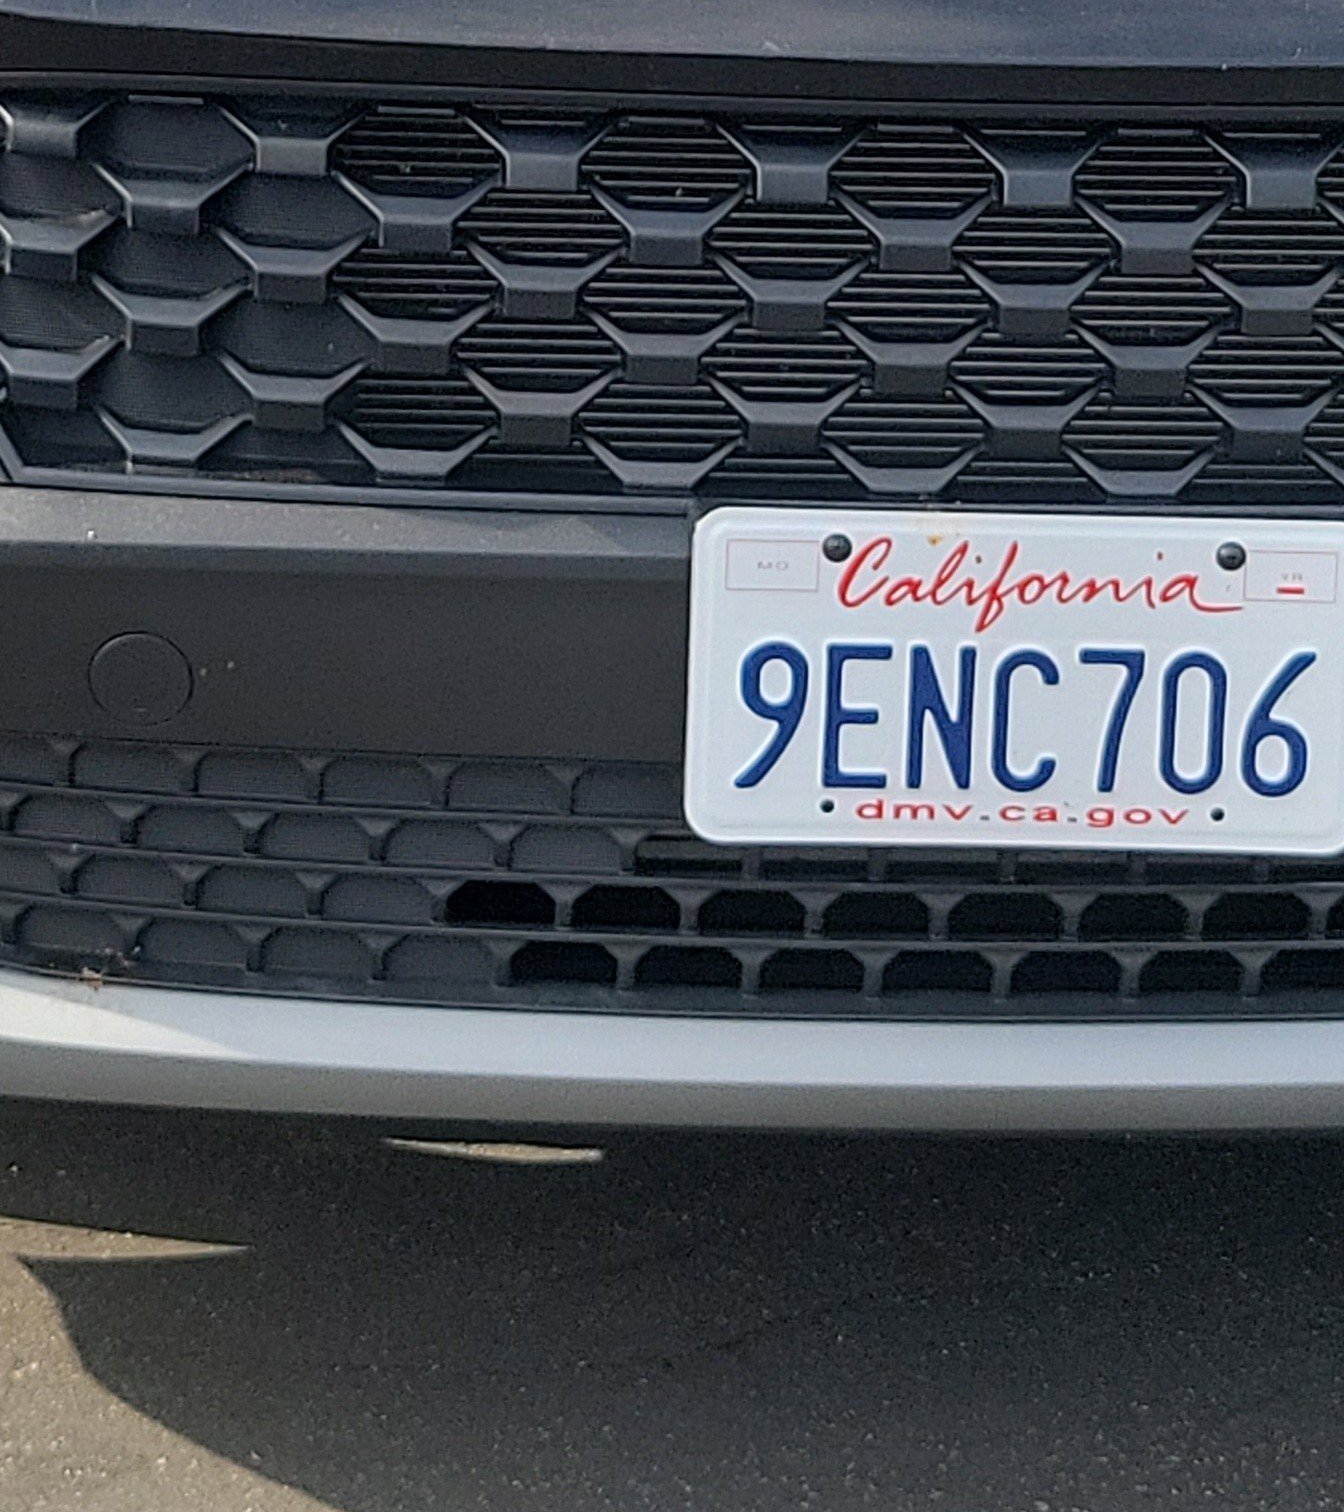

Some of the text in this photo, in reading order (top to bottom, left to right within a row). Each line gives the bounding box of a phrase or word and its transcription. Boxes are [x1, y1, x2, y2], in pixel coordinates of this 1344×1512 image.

[836, 536, 1244, 633] California
[732, 639, 1318, 798] 9ENC706
[855, 798, 1190, 828] dmv.ca.gov
